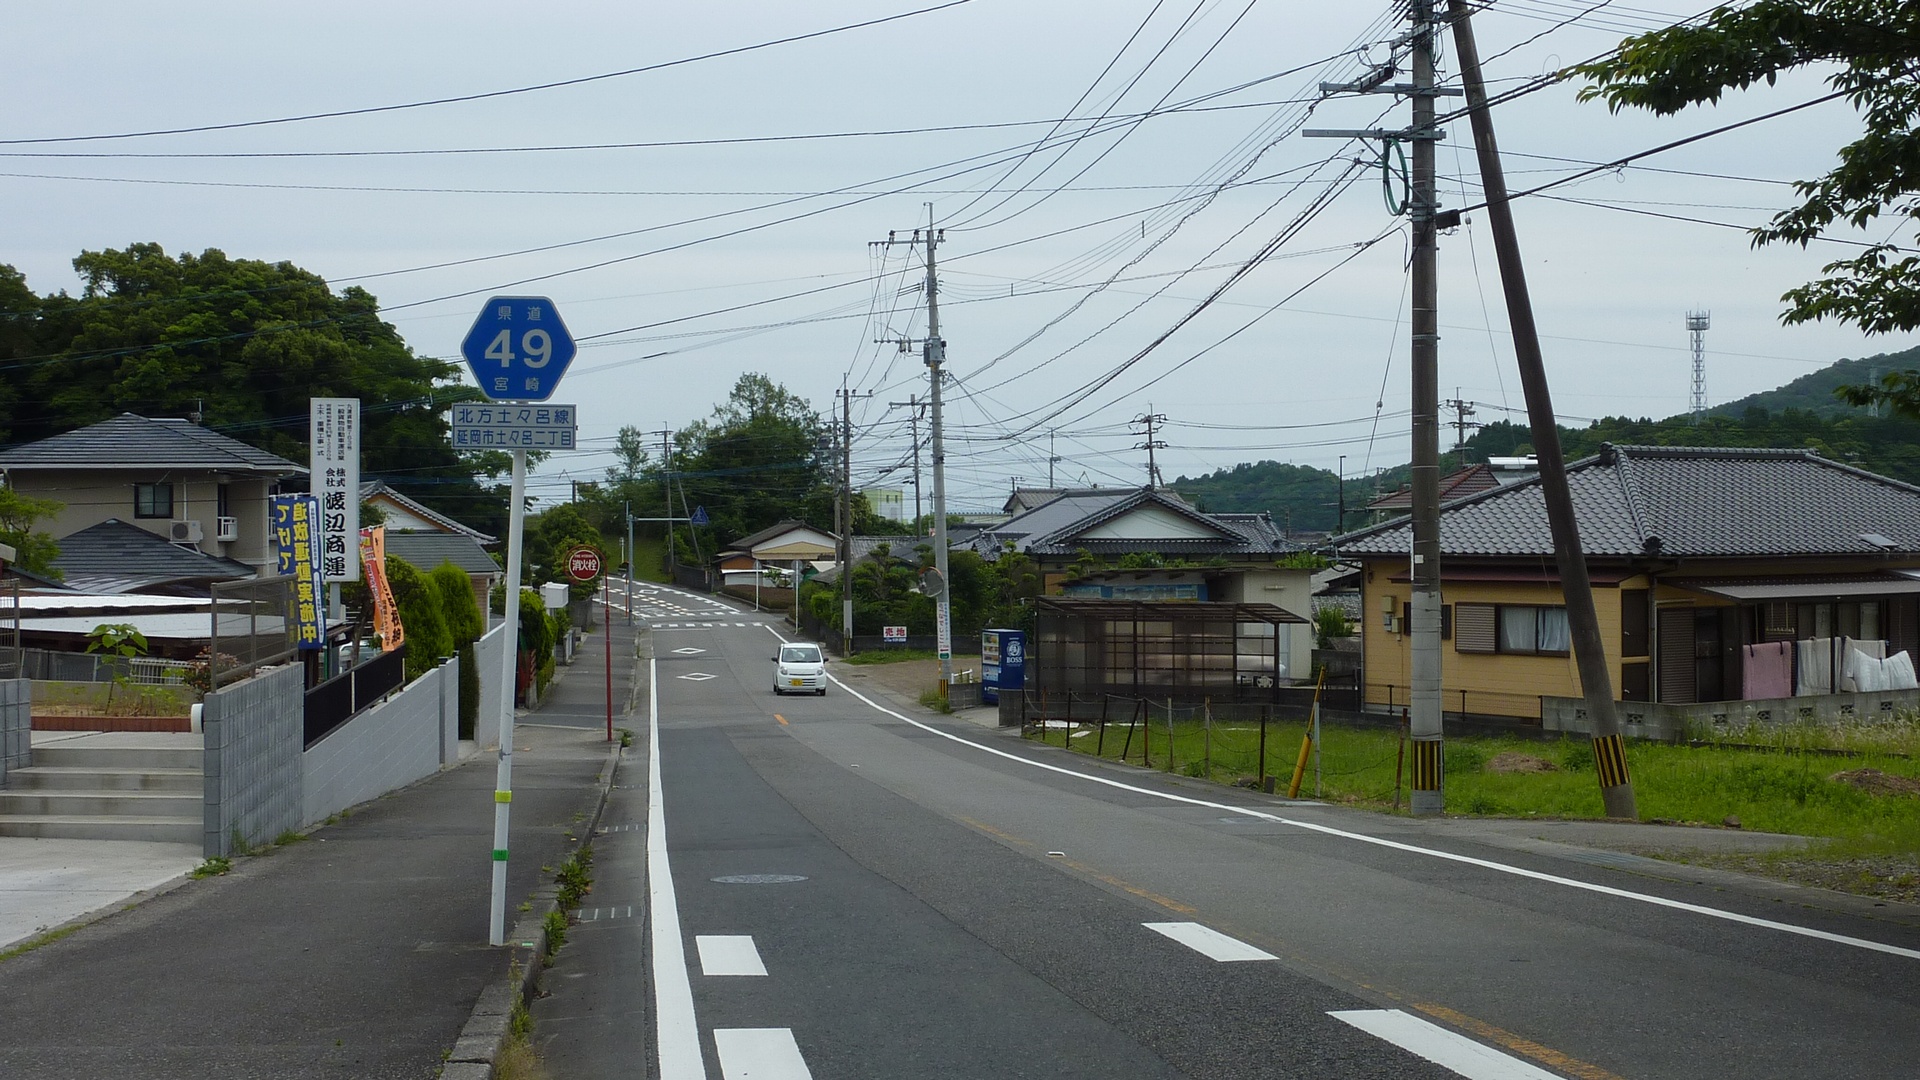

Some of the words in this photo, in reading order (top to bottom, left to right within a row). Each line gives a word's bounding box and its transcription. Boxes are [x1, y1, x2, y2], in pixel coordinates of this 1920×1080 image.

[497, 305, 542, 321] 県道
[484, 328, 552, 369] 49
[494, 376, 540, 392] 宮崎
[458, 408, 570, 425] 北方土々呂線
[456, 430, 572, 446] 延岡市土々呂二丁目
[325, 491, 346, 577] 渡辺商運
[572, 559, 597, 571] 消火栓
[884, 627, 906, 637] 売地
[1006, 656, 1023, 664] BOSS
